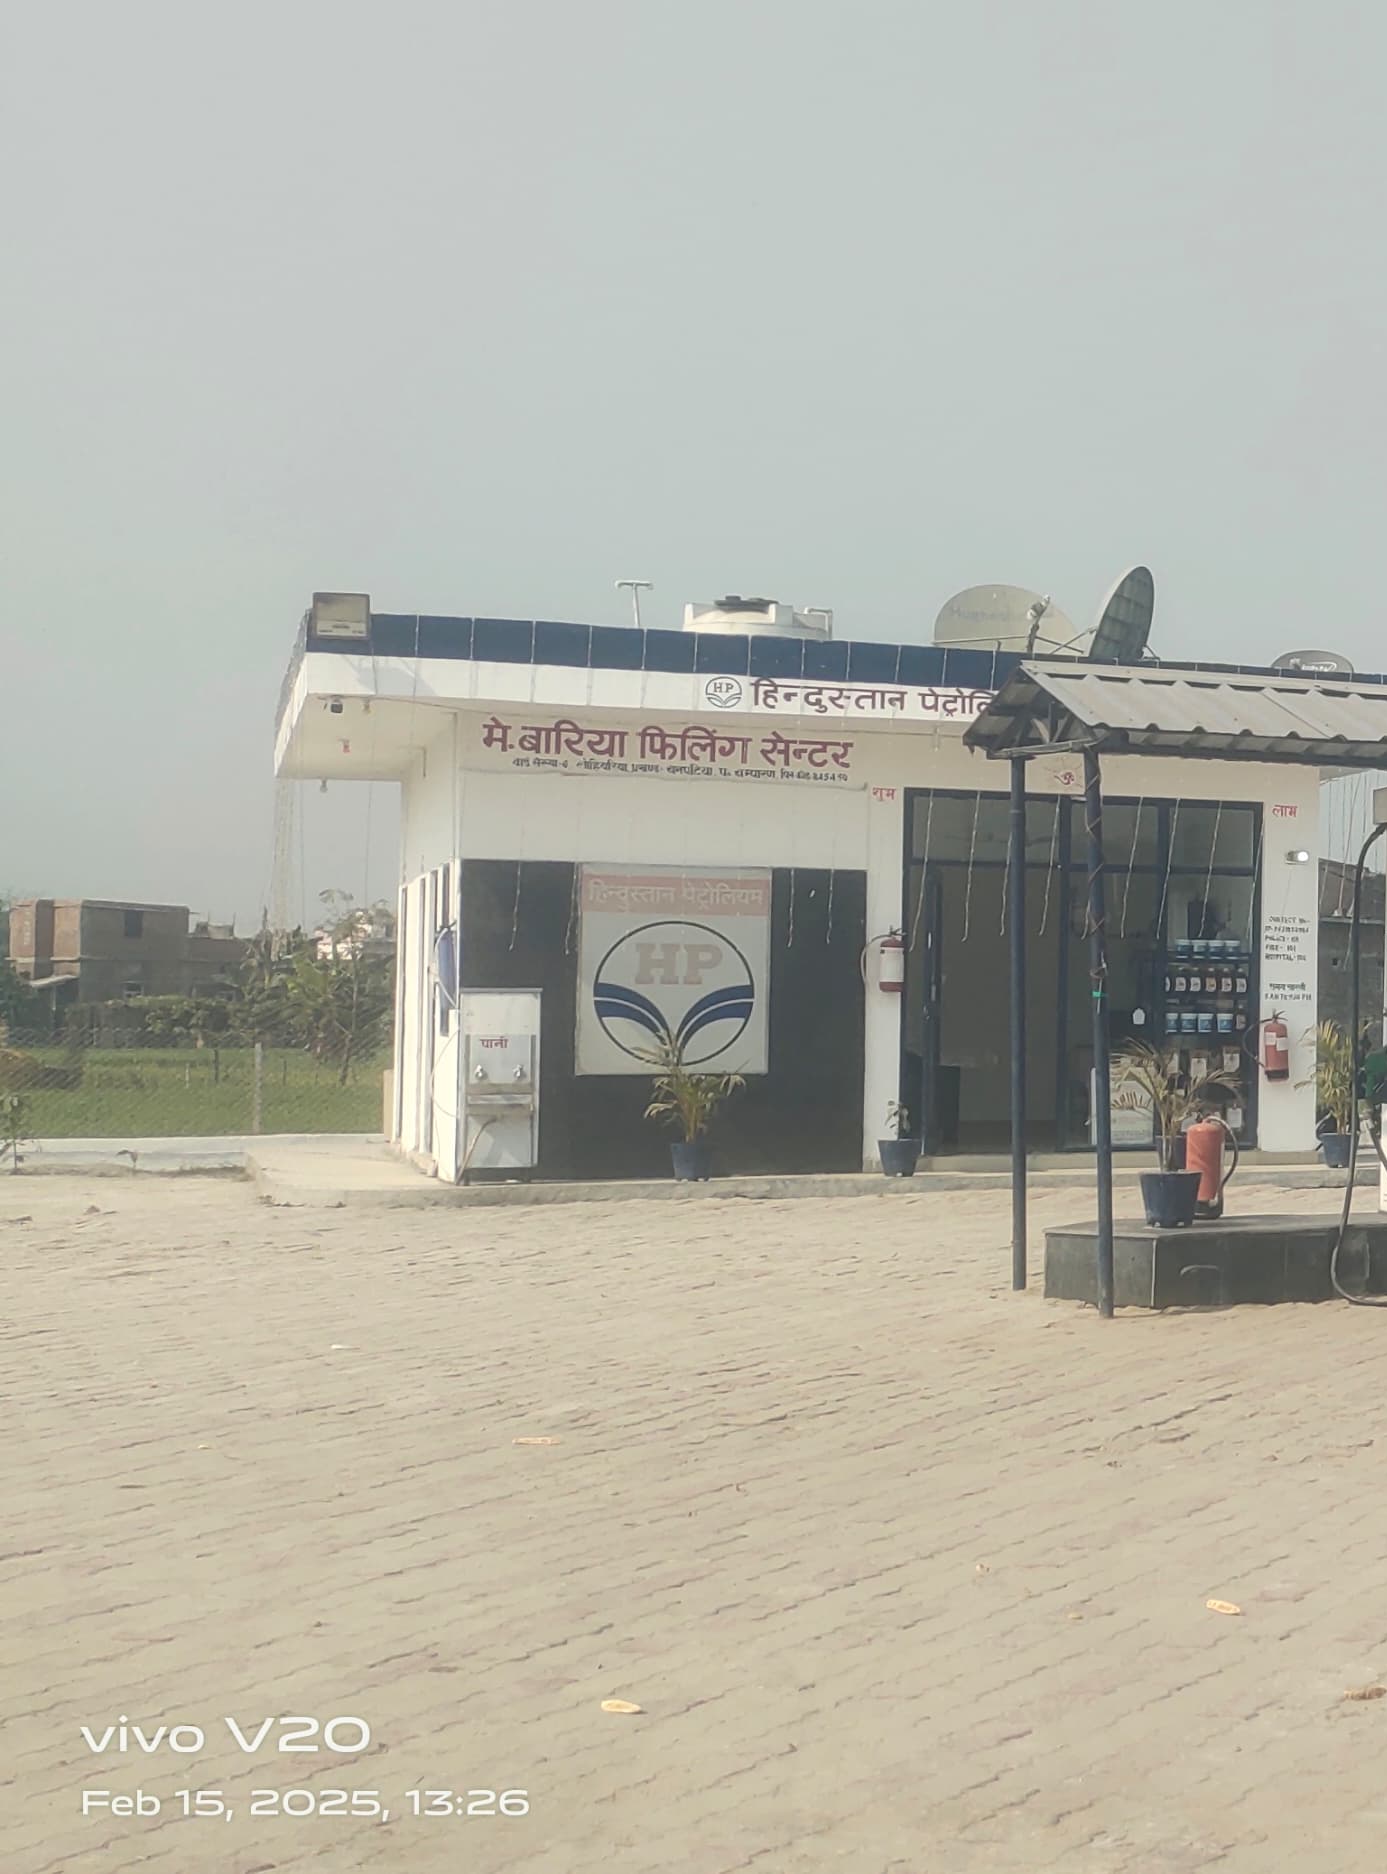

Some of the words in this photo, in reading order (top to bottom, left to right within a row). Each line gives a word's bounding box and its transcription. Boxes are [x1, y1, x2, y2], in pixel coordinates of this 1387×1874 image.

[713, 682, 734, 693] HP
[750, 677, 907, 714] हिन्दुस्तान
[518, 719, 629, 758] बारिया
[636, 725, 752, 764] फिलिंग
[760, 731, 854, 768] सेन्टर
[589, 879, 676, 909] हिन्दुस्तान
[682, 881, 763, 911] पेट्रोलियम
[635, 943, 724, 984] HP
